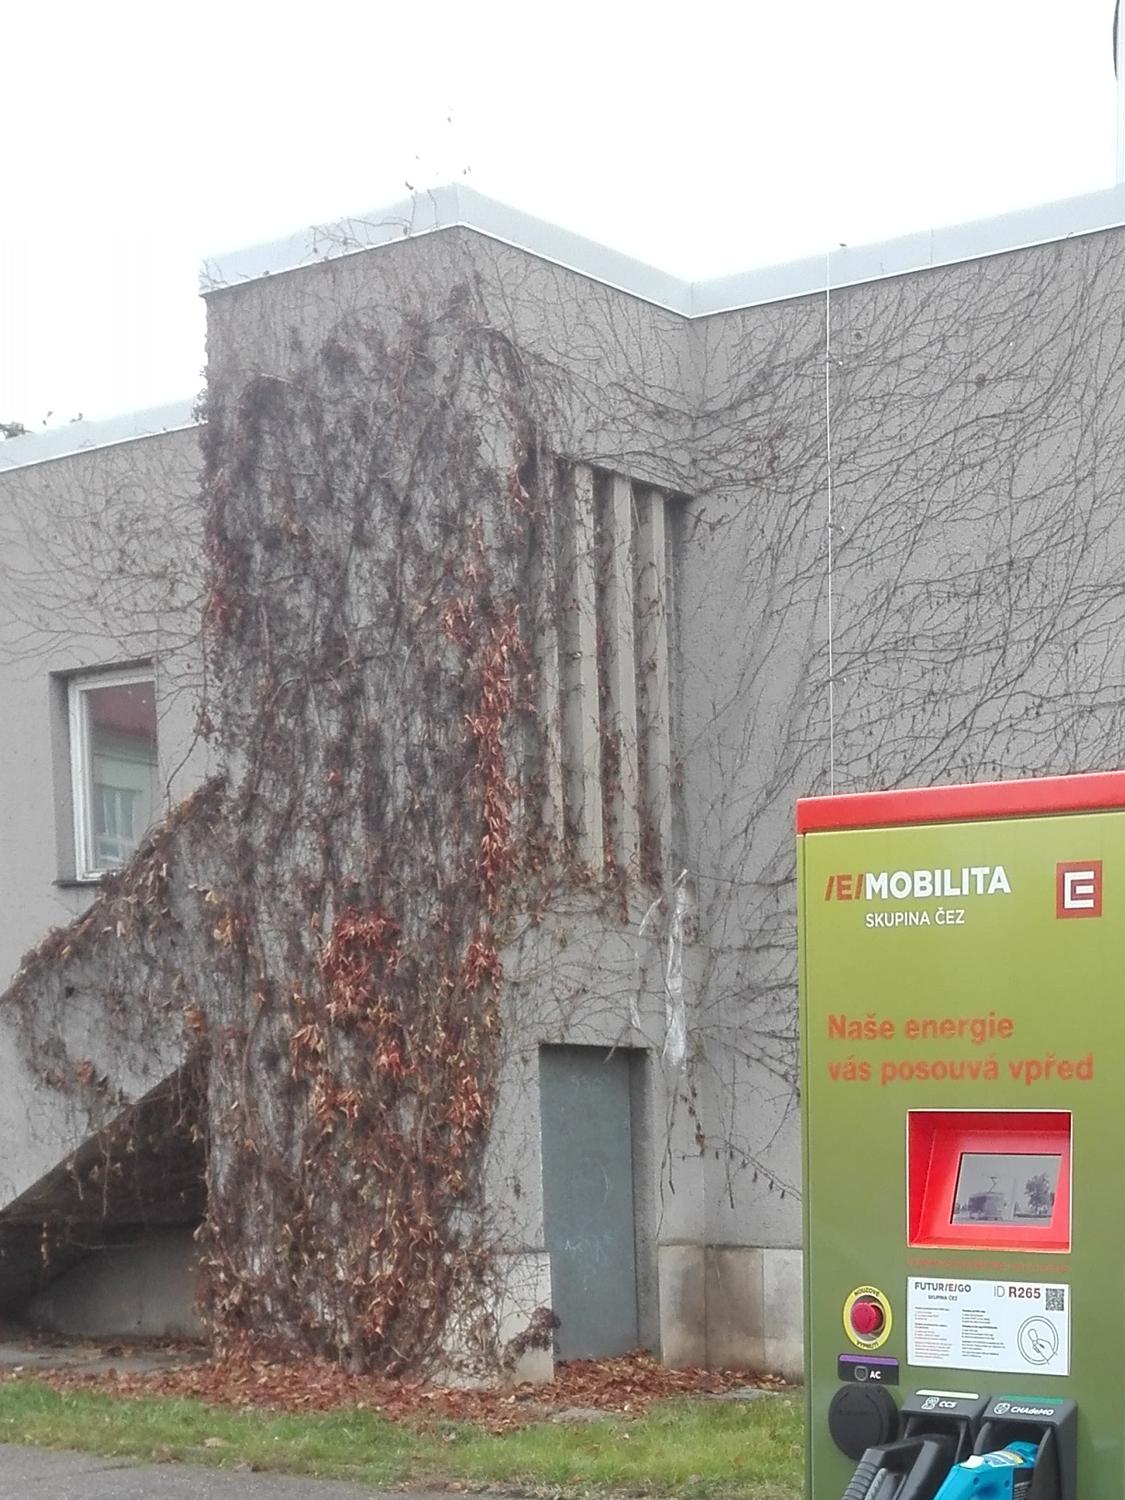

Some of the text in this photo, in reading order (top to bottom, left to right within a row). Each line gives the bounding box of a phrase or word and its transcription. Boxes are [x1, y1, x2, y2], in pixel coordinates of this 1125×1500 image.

[865, 907, 966, 928] SKUPINA ČEZ
[827, 1011, 1015, 1045] Naše energie
[827, 1051, 1094, 1086] vás posouvá vpřed
[993, 1285, 1042, 1299] ID R265
[869, 1370, 882, 1380] AC
[939, 1400, 958, 1409] CCS
[1010, 1405, 1055, 1416] CHAdeMO
